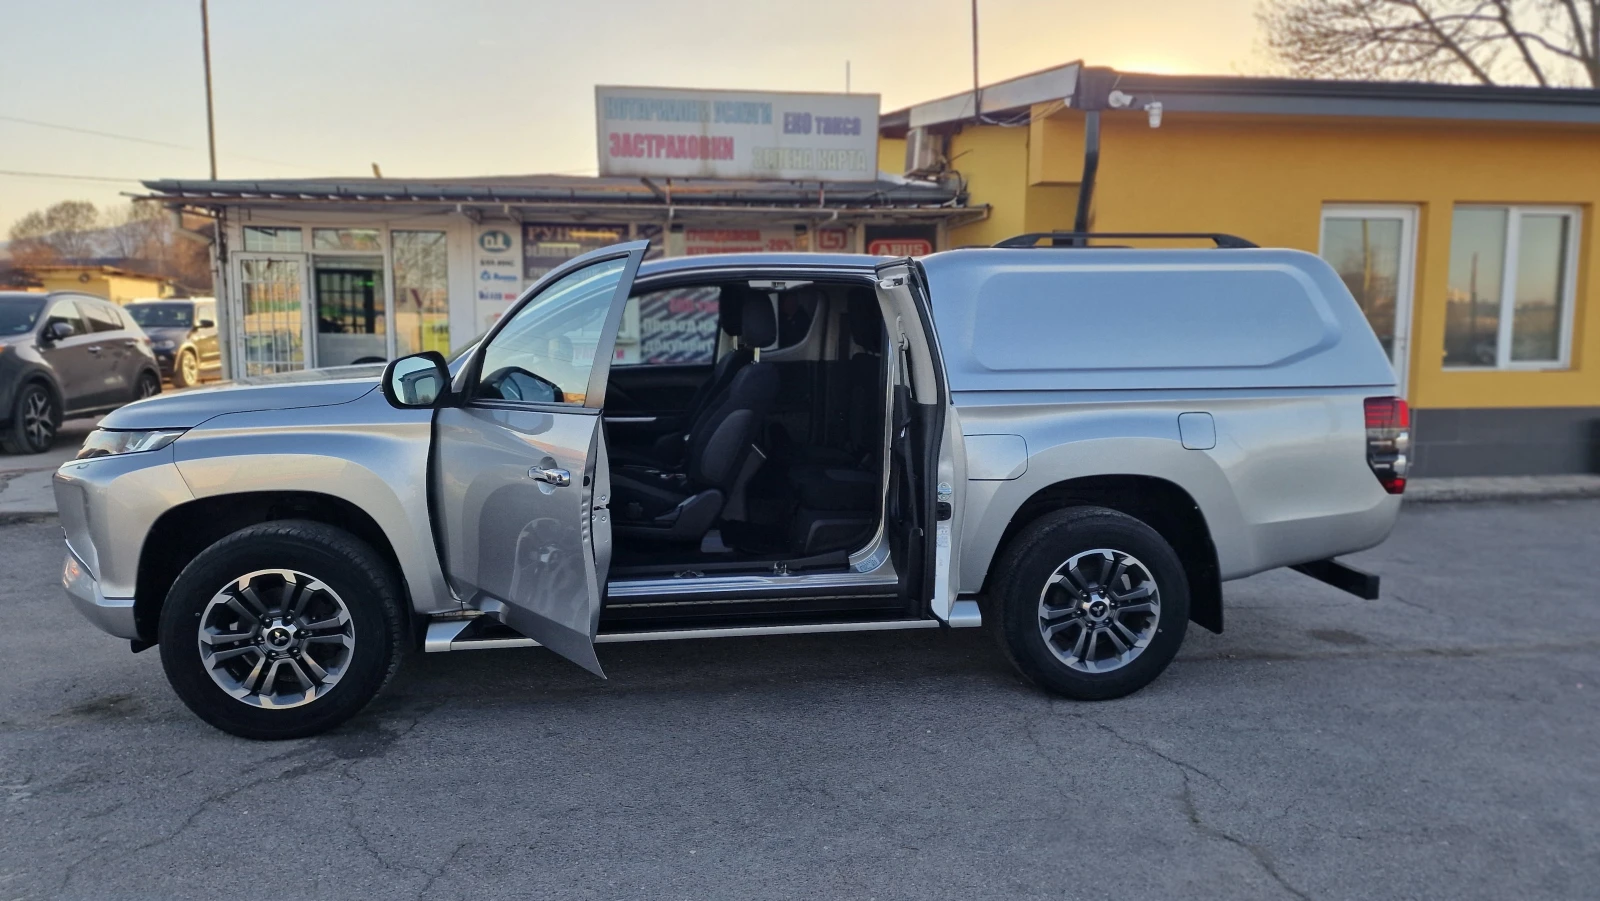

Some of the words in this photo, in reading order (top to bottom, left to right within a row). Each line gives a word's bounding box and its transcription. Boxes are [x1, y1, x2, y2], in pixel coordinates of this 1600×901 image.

[609, 133, 734, 160] ЗАСТРАХОВКИ
[816, 148, 868, 171] КАРТА
[878, 243, 923, 256] ABUS
